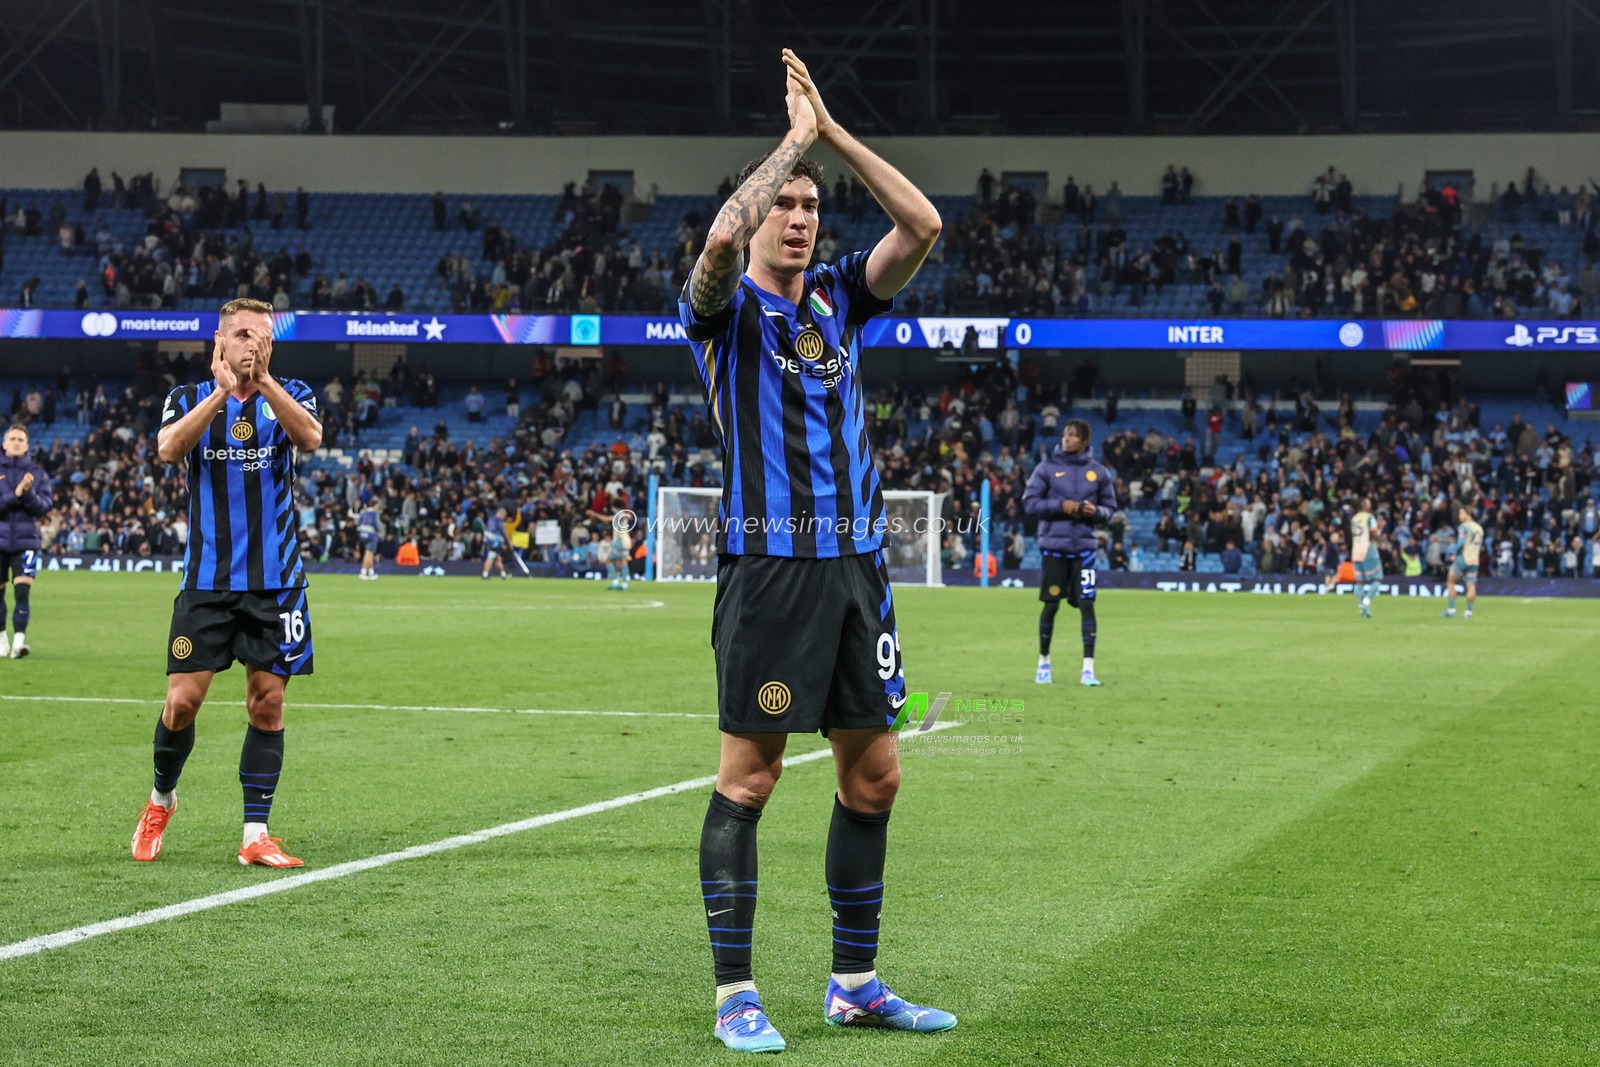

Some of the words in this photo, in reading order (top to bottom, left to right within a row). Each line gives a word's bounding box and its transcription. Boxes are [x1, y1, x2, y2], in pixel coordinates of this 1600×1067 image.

[121, 317, 199, 331] mastercard
[346, 320, 420, 336] Heineken
[646, 322, 688, 339] MAN
[896, 323, 911, 344] 0
[1015, 323, 1031, 345] 0
[1168, 326, 1223, 343] INTER
[1537, 327, 1597, 343] PS5
[771, 346, 848, 377] betssn
[820, 360, 852, 388] .sprt
[203, 446, 277, 461] betsson
[25, 550, 34, 565] 7
[1080, 569, 1096, 586] 31
[279, 609, 305, 644] 16
